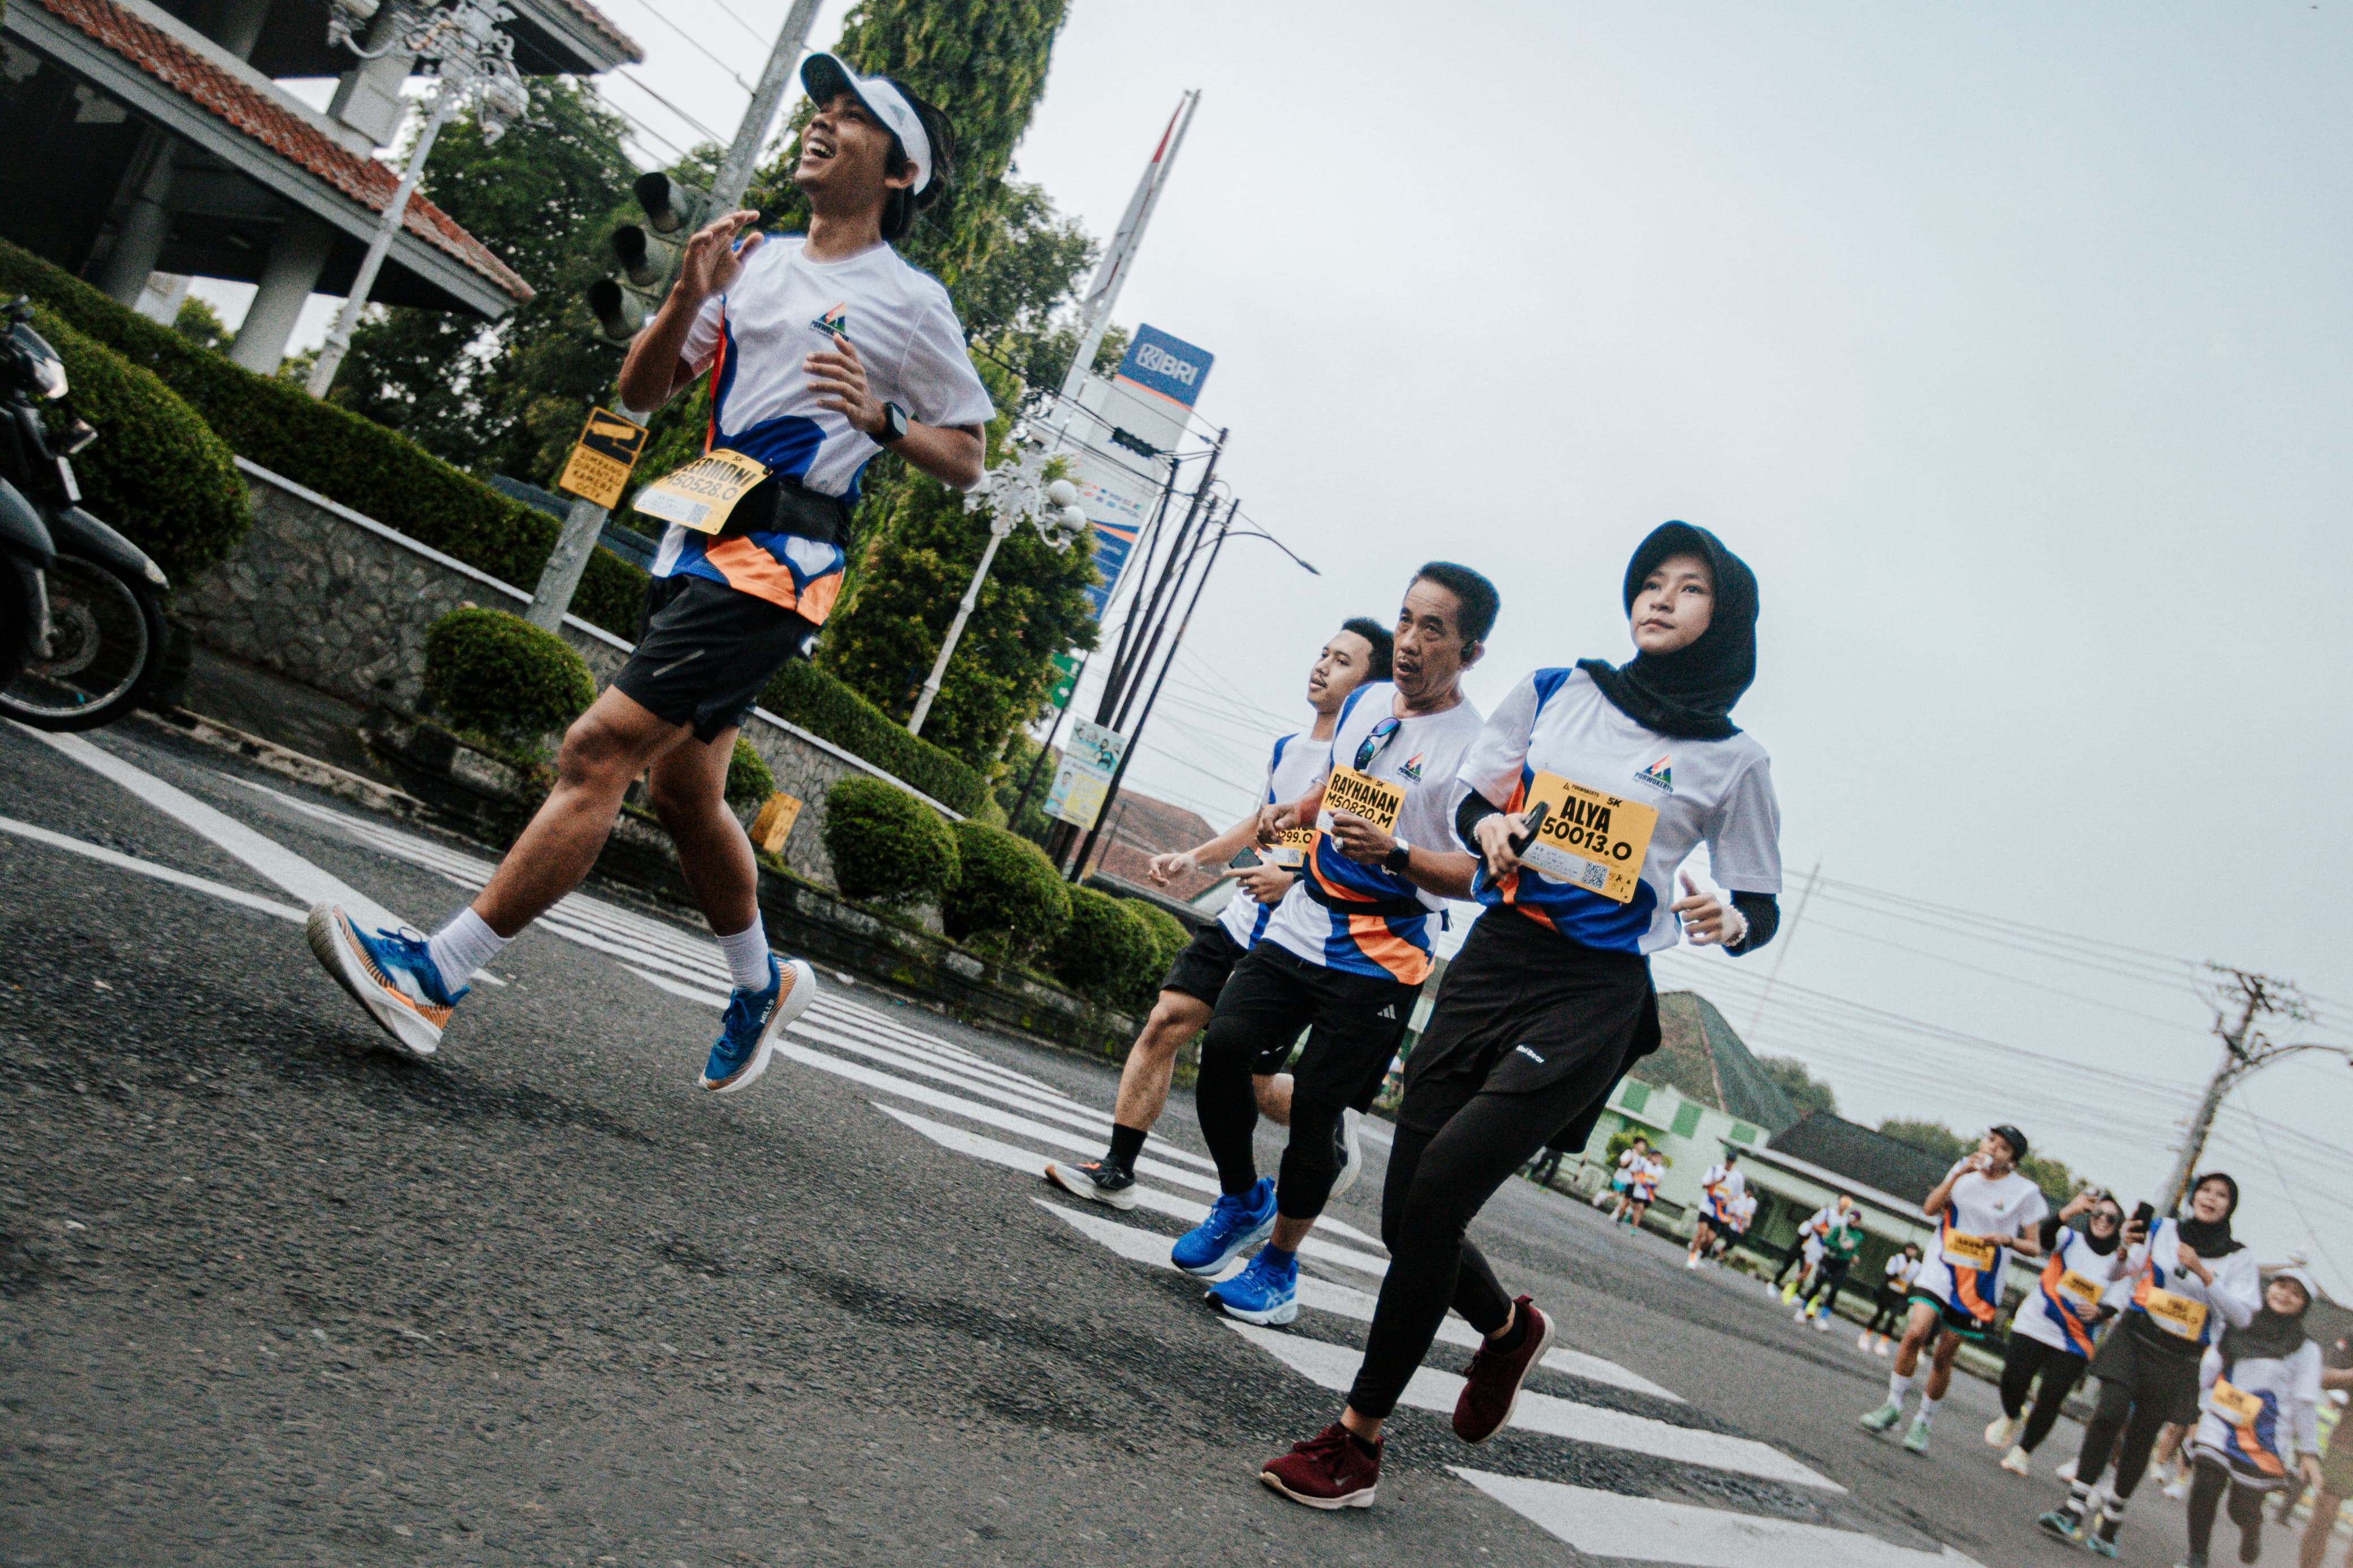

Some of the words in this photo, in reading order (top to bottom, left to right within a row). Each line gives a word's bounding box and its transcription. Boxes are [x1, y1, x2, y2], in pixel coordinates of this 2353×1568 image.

[1159, 353, 1199, 386] BRI
[1330, 773, 1399, 815] RAYHANAN
[1634, 771, 1674, 793] PURWOKERTO
[1325, 791, 1393, 829] M50820.M
[1559, 795, 1611, 834] ALYA
[1606, 797, 1623, 808] 5K
[760, 999, 774, 1024] MILLS
